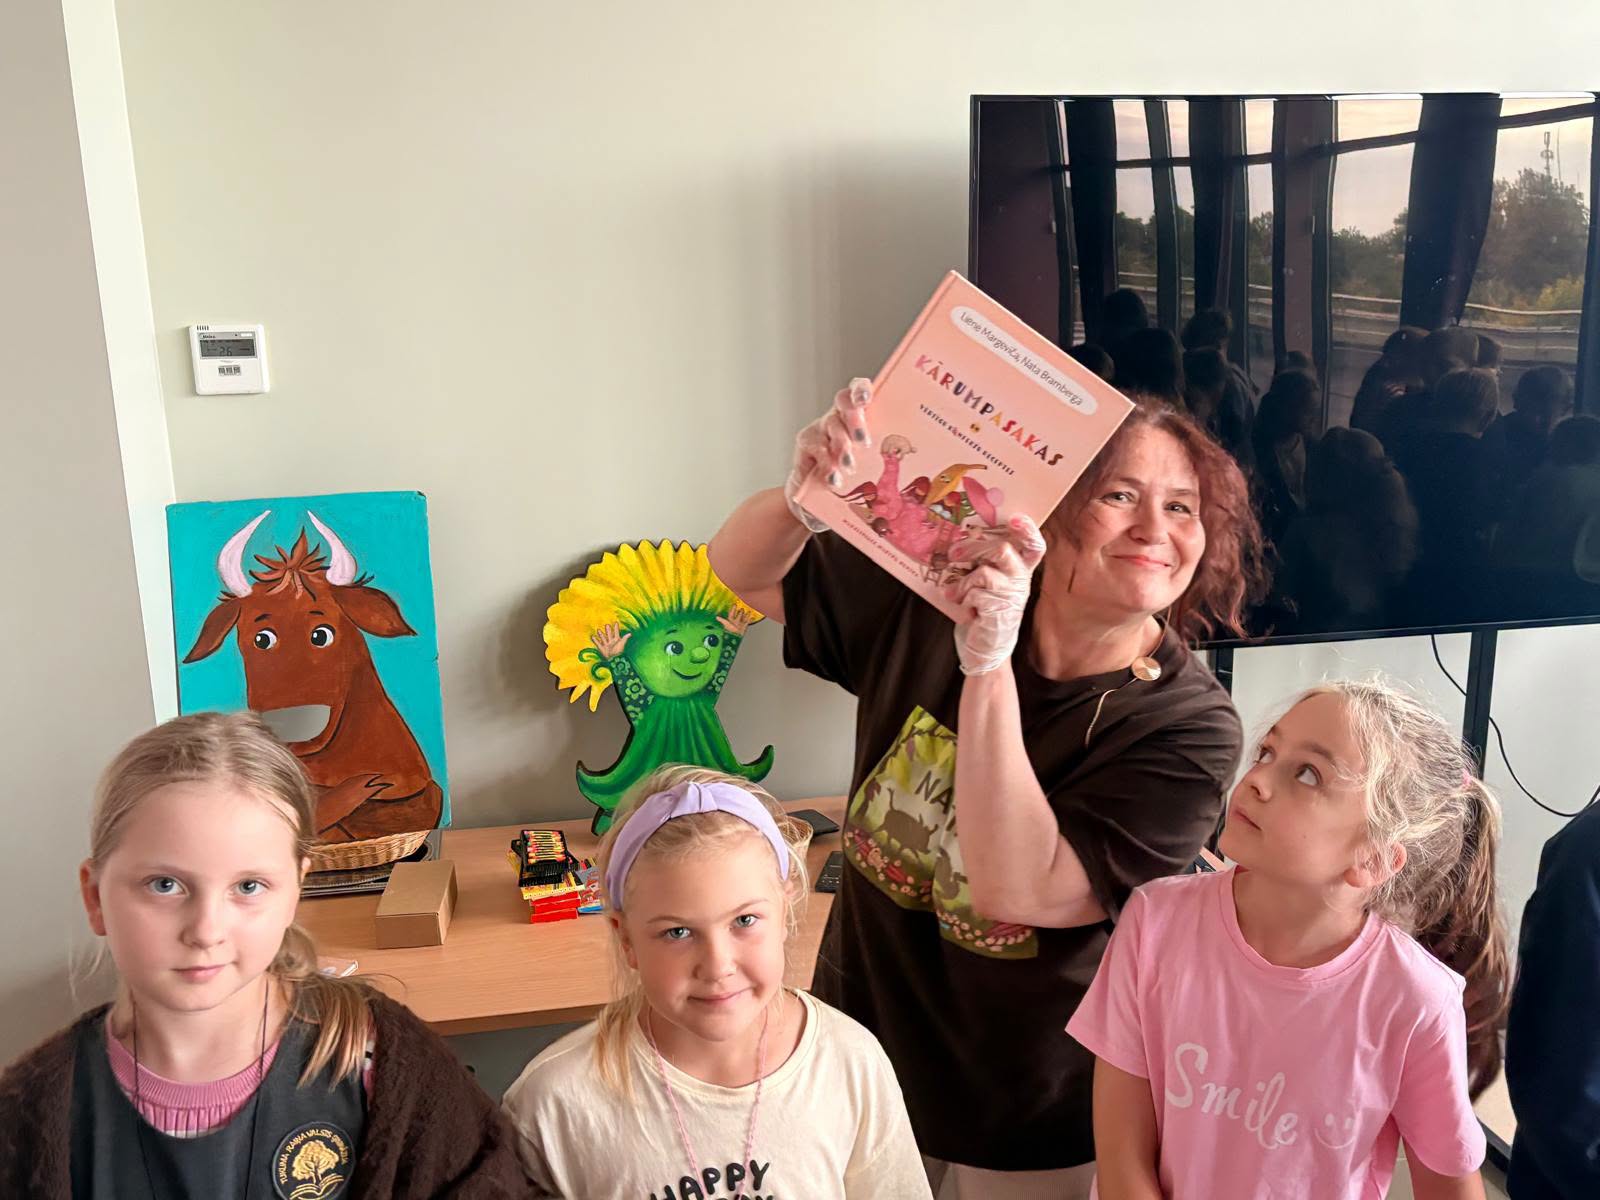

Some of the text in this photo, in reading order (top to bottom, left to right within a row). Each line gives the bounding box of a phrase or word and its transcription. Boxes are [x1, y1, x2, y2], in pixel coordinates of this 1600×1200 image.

[914, 354, 1064, 466] KĀRUMPASAKAS
[1020, 356, 1041, 375] Nata
[1040, 370, 1083, 406] Bramberga
[1164, 1042, 1299, 1150] Smile
